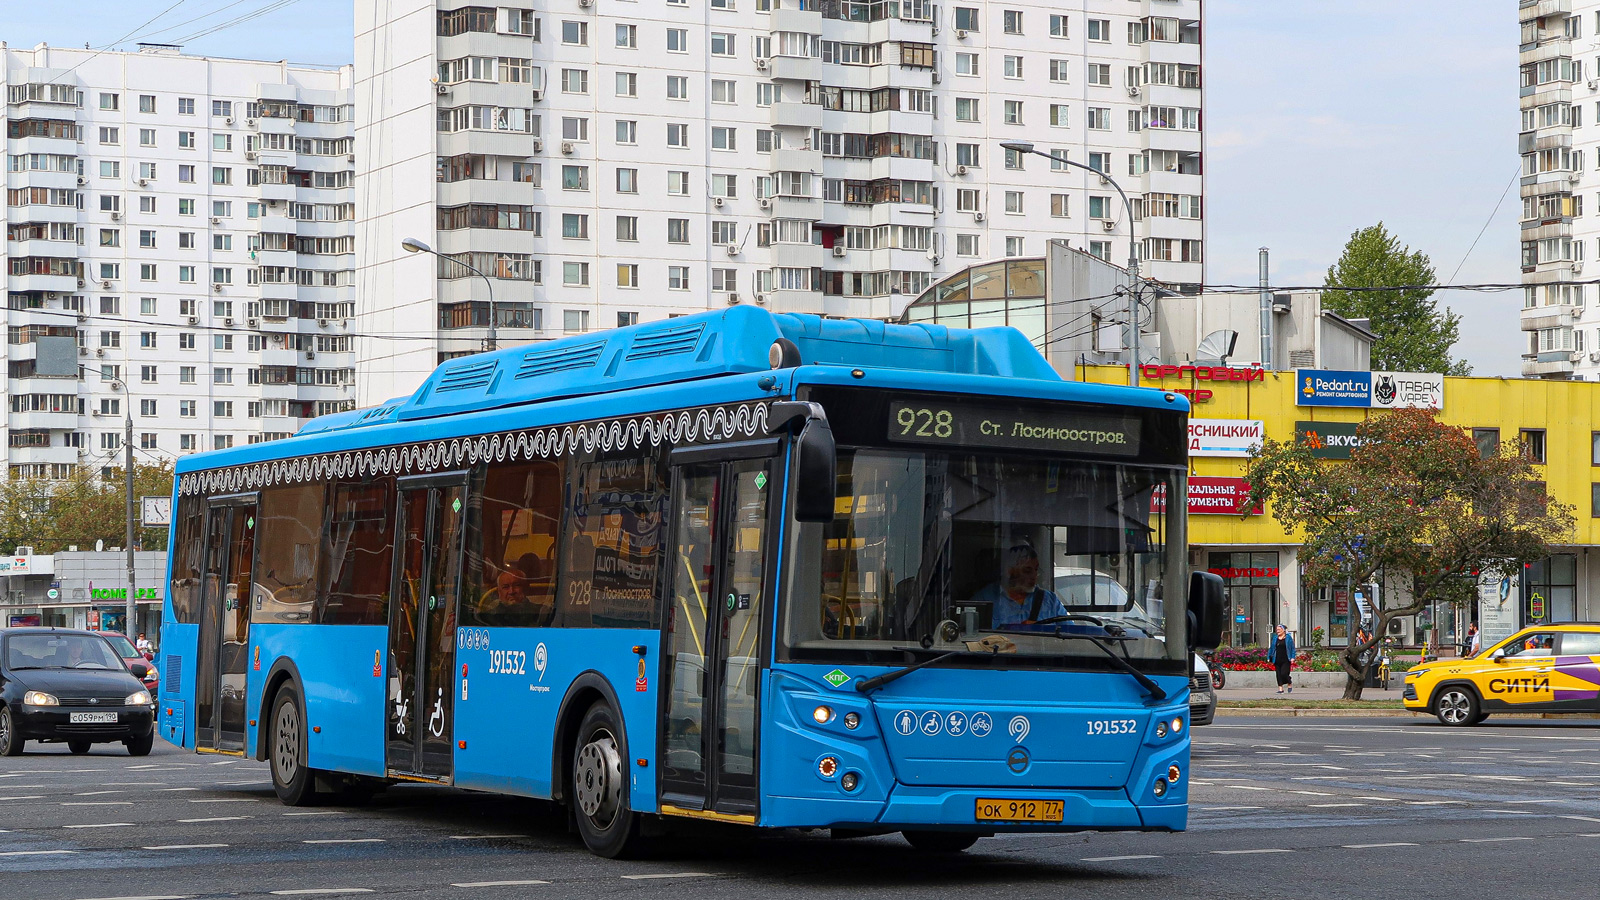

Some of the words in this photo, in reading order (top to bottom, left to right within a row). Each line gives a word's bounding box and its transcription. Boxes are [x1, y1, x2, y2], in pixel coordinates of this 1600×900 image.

[1126, 362, 1264, 381] ОРГОВЫЙ
[1316, 378, 1368, 392] Pedant.ru
[1397, 381, 1440, 393] ТАБАК
[1400, 393, 1429, 403] VAPE
[897, 407, 953, 438] 928
[979, 420, 1003, 436] Ст.
[1011, 422, 1127, 445] Лосиноостров.
[1188, 422, 1259, 438] ЯСНИЦКИЙ
[1327, 434, 1376, 447] ВКУС
[1267, 567, 1279, 578] 24
[92, 588, 157, 599] ЛОМБРД
[569, 580, 592, 605] 928
[488, 649, 526, 675] 191532
[1489, 678, 1549, 693] СИТИ
[72, 713, 103, 722] С059РМ
[1086, 719, 1137, 735] 191532
[984, 804, 1002, 818] ОК
[1009, 802, 1036, 818] 912
[1044, 802, 1059, 815] 77
